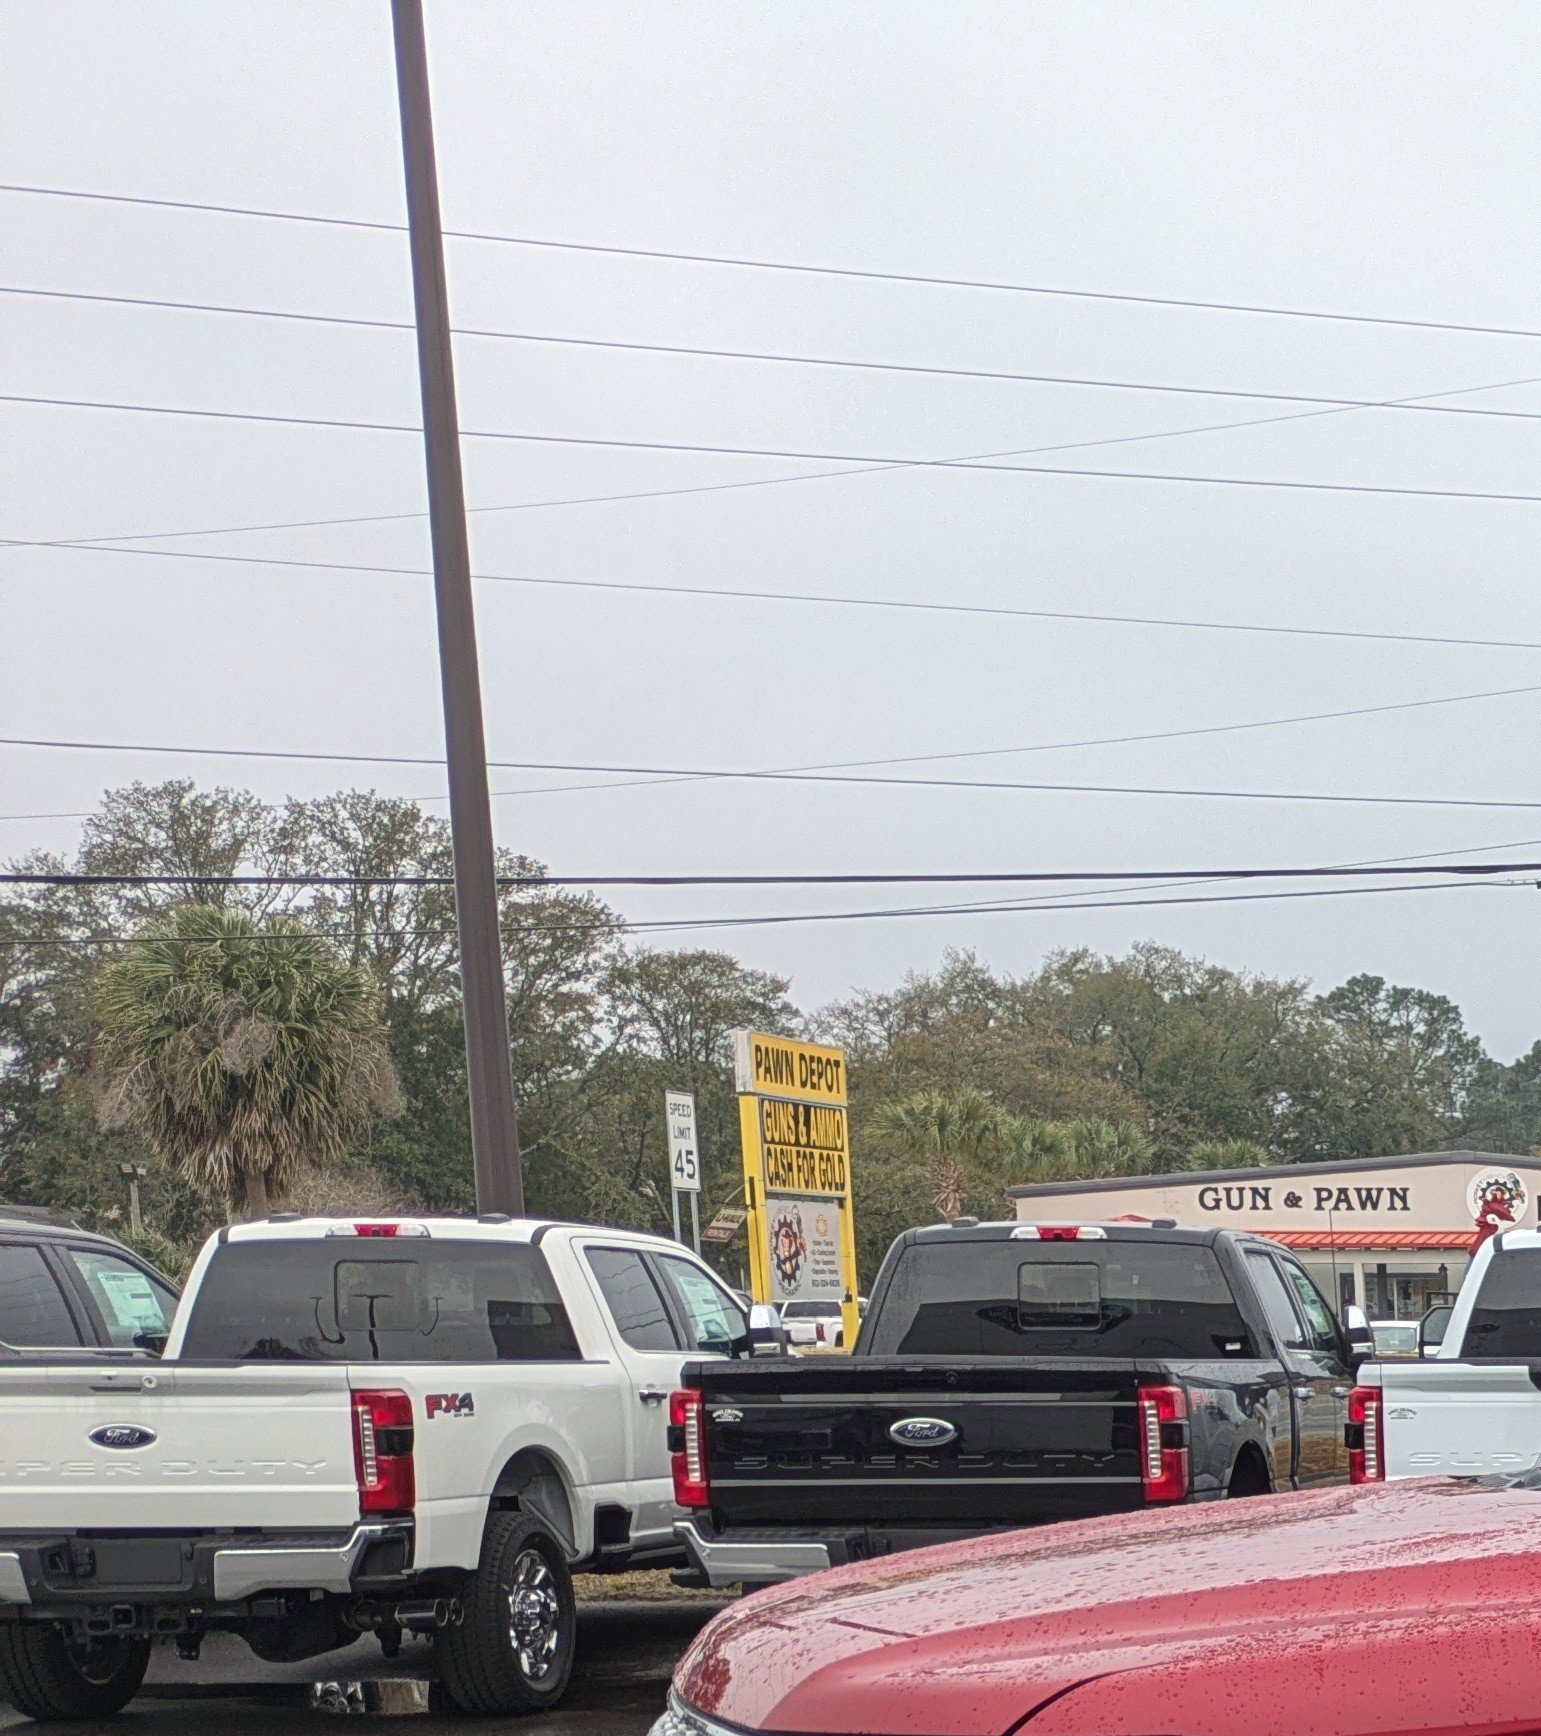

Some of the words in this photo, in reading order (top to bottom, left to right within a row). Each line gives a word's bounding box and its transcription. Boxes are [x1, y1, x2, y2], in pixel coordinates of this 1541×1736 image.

[754, 1044, 796, 1088] PAWN
[798, 1052, 841, 1095] DEPOT
[669, 1102, 692, 1118] SPEED
[672, 1125, 692, 1141] LIMIT
[762, 1099, 796, 1145] GUNS
[798, 1104, 807, 1146] &
[809, 1106, 843, 1150] AMMO
[674, 1148, 696, 1180] 45
[766, 1145, 796, 1189] CASH
[795, 1150, 818, 1191] FOR
[818, 1152, 846, 1193] GOLD
[1198, 1186, 1273, 1211] GUN
[1283, 1191, 1303, 1209] &
[1313, 1187, 1411, 1212] PAWN
[425, 1392, 475, 1419] FX4
[0, 1459, 142, 1476] PER
[160, 1459, 327, 1476] DUTY
[734, 1455, 939, 1470] SUPER
[957, 1453, 1115, 1468] DUTY
[1408, 1452, 1541, 1467] SUP
